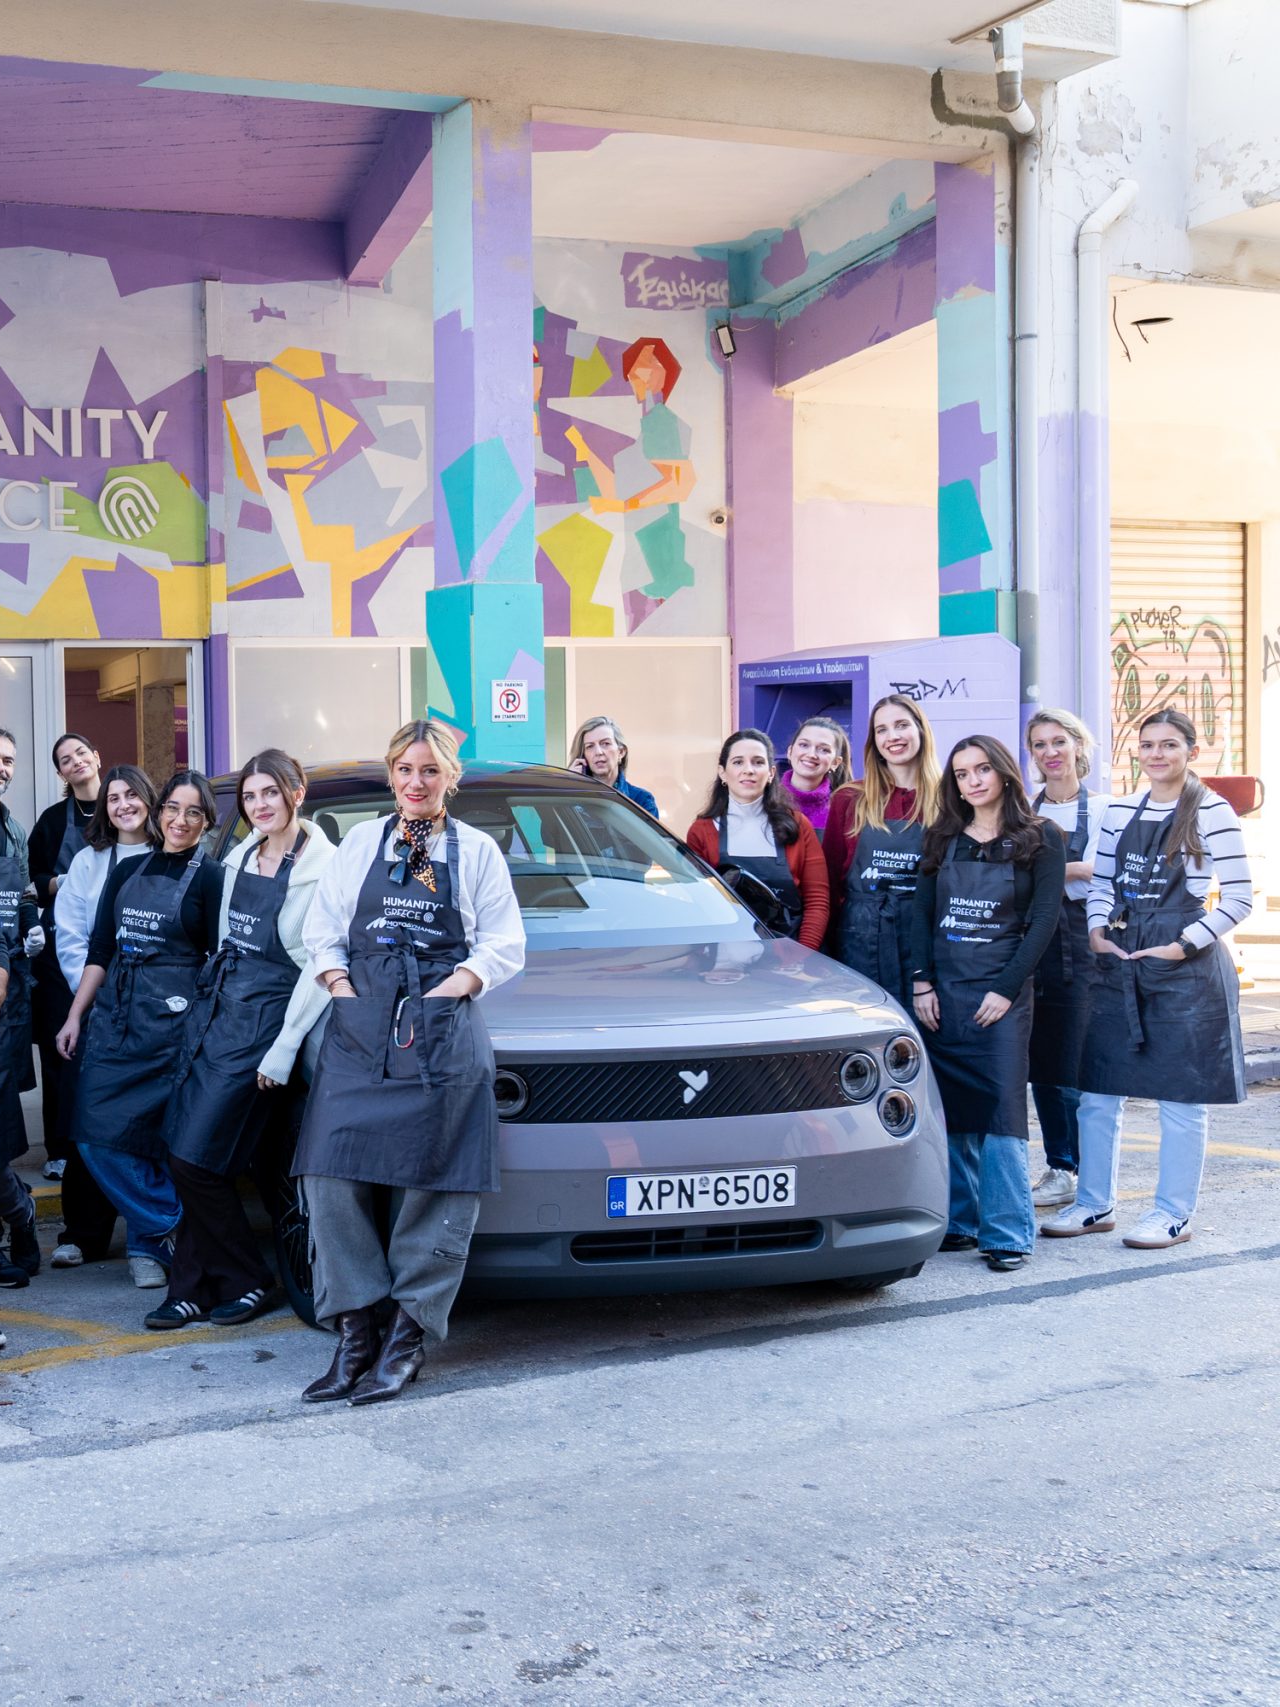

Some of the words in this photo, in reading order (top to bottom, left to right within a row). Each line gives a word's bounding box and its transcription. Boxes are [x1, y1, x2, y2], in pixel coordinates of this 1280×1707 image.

[780, 664, 815, 678] Ενδυμάτων
[823, 660, 864, 675] Υποδημάτων
[872, 849, 921, 862] HUMANITY
[871, 859, 907, 870] GREECE
[383, 896, 440, 911] HUMANITY
[950, 897, 997, 909] HUMANITY
[122, 907, 163, 921] HUMANITY
[384, 907, 422, 921] GREECE
[949, 906, 982, 918] GREECE
[121, 916, 150, 929] GREECE
[610, 1200, 625, 1211] GR
[637, 1172, 790, 1211] XPN-6508
